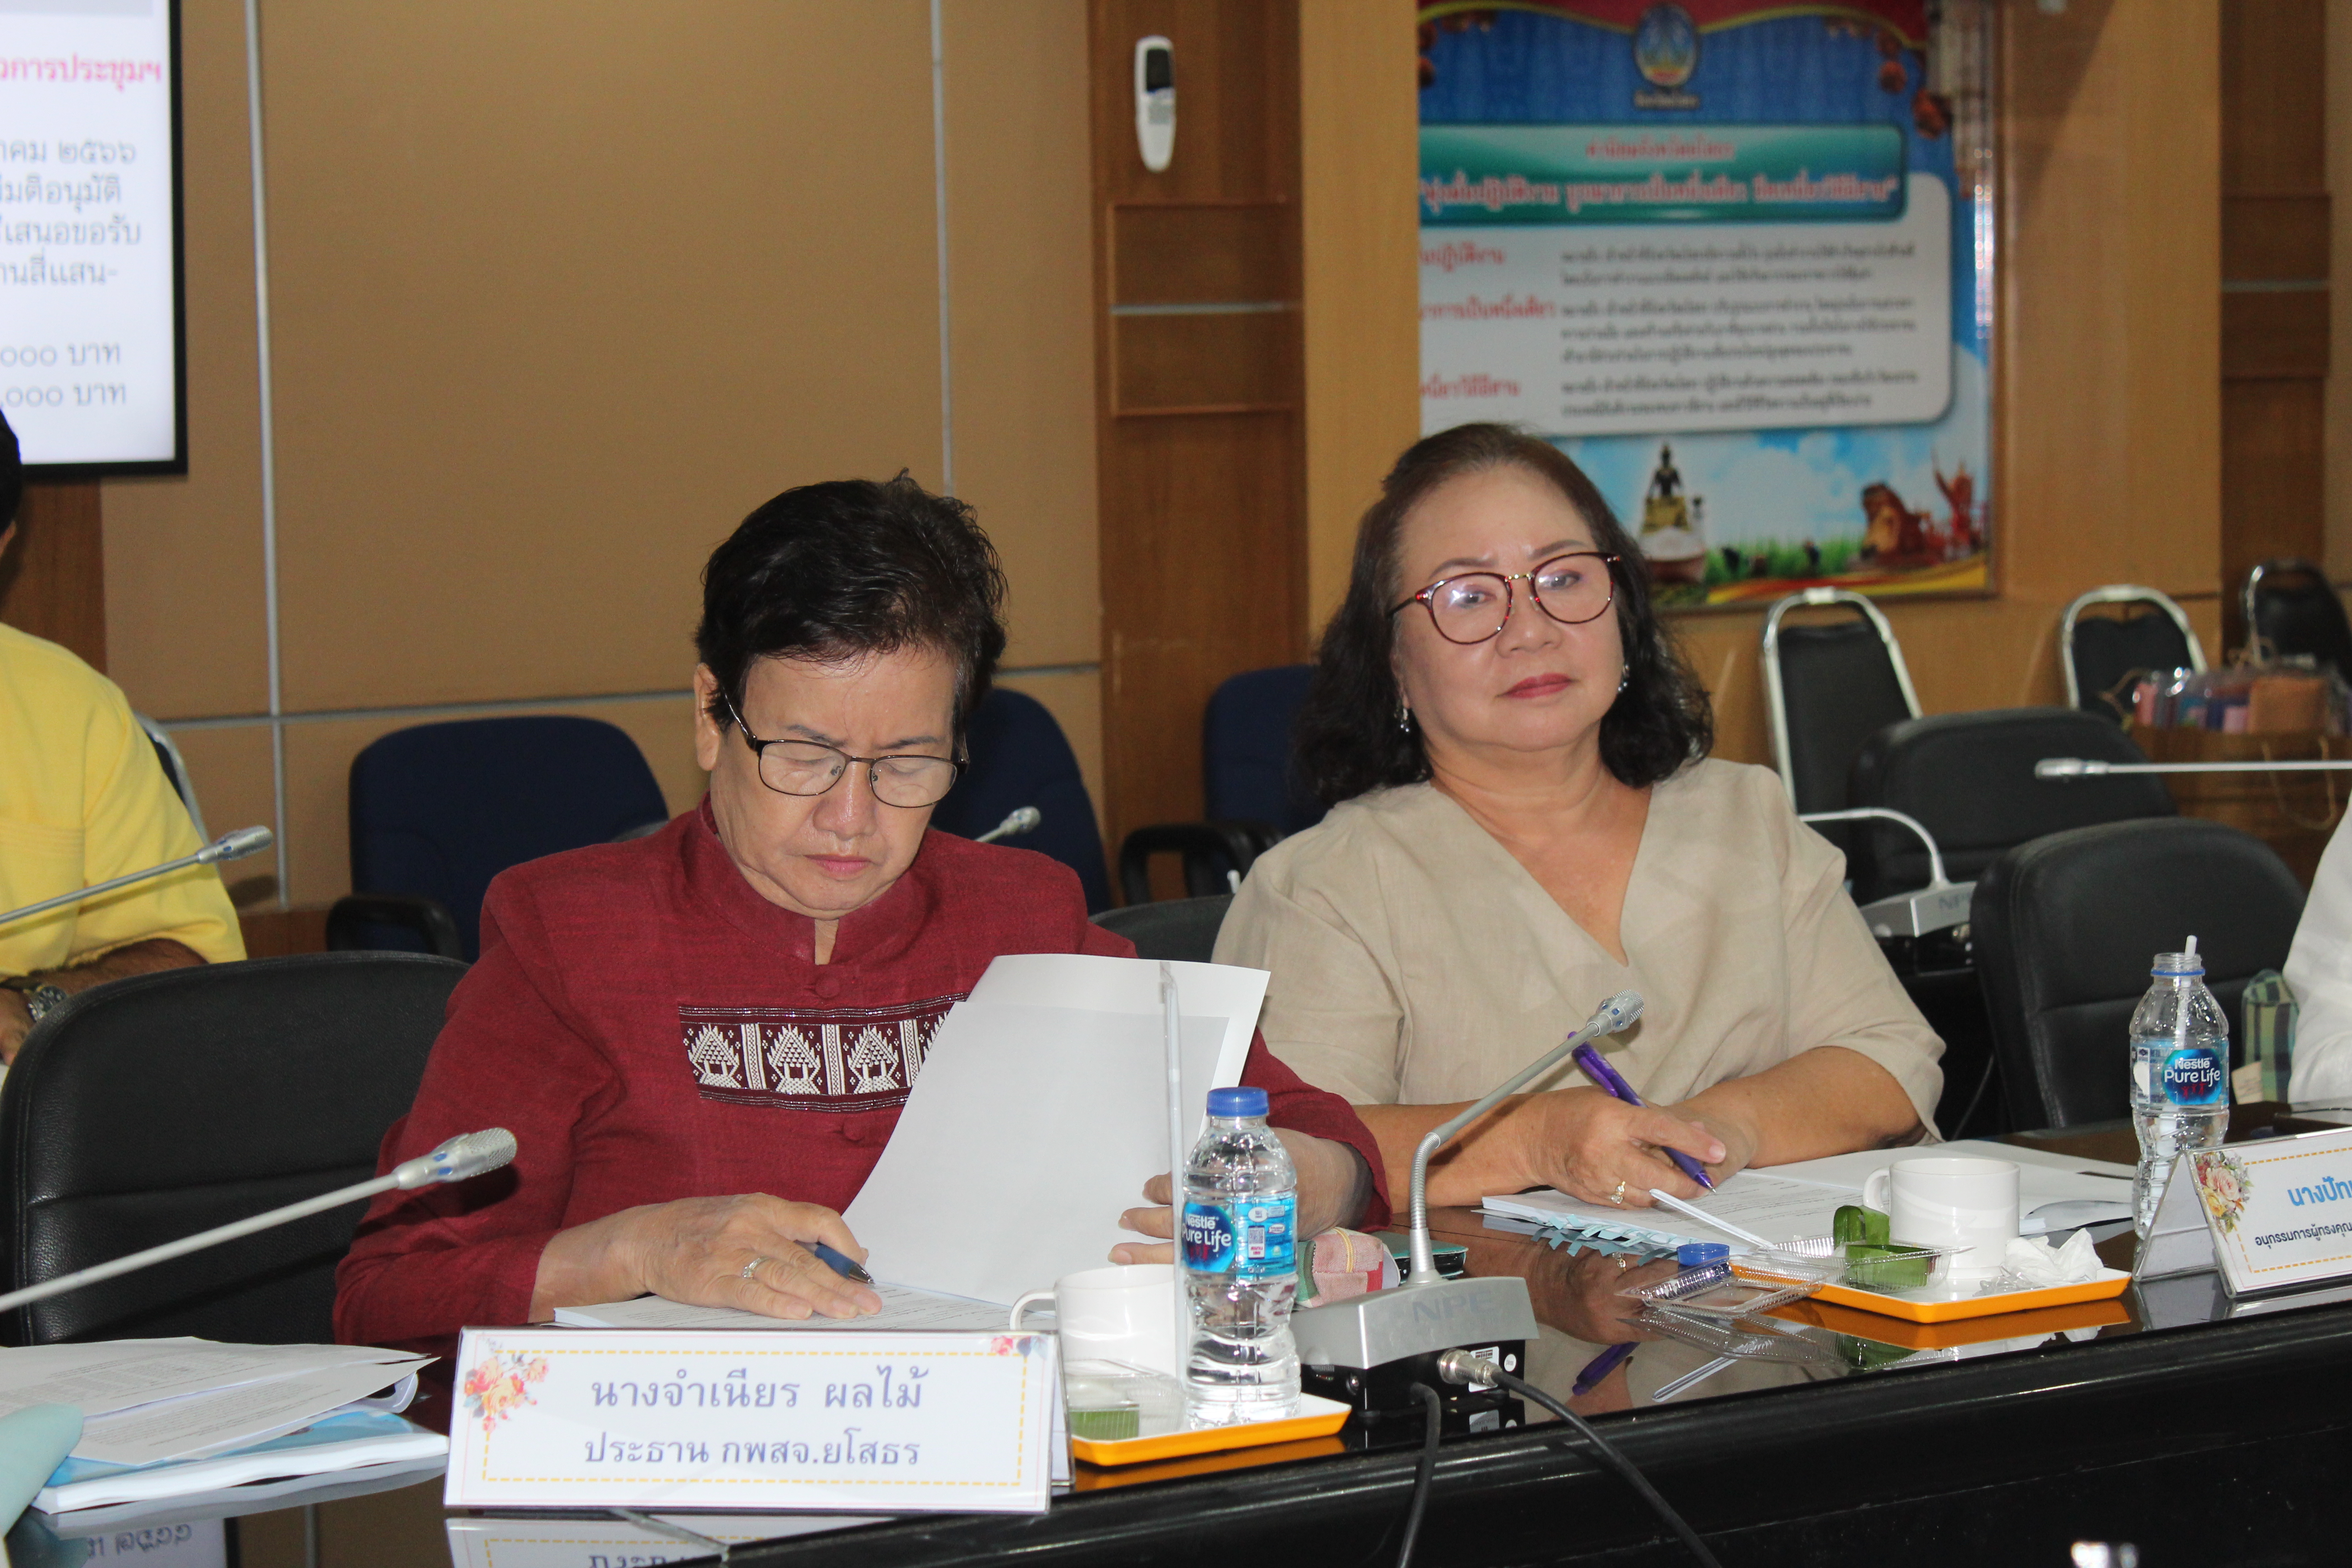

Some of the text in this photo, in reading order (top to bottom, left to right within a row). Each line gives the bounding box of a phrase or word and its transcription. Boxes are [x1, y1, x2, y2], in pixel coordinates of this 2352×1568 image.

[58, 139, 137, 163] ๒๕๖๖
[0, 173, 122, 213] มติอนุมัติ
[0, 213, 142, 244] เสนอขอรับ
[67, 343, 121, 366] บาท
[73, 383, 127, 406] บาท
[2164, 1068, 2221, 1087] Pure Life
[2287, 1176, 2352, 1206] นางปัท
[1181, 1224, 1202, 1244] Pure
[1204, 1230, 1232, 1252] Life
[1412, 1290, 1494, 1323] NPE
[591, 1365, 929, 1408] นางจำเนียร ผลไม้
[585, 1427, 920, 1465] ประธาน กพสจ.ยโสธร
